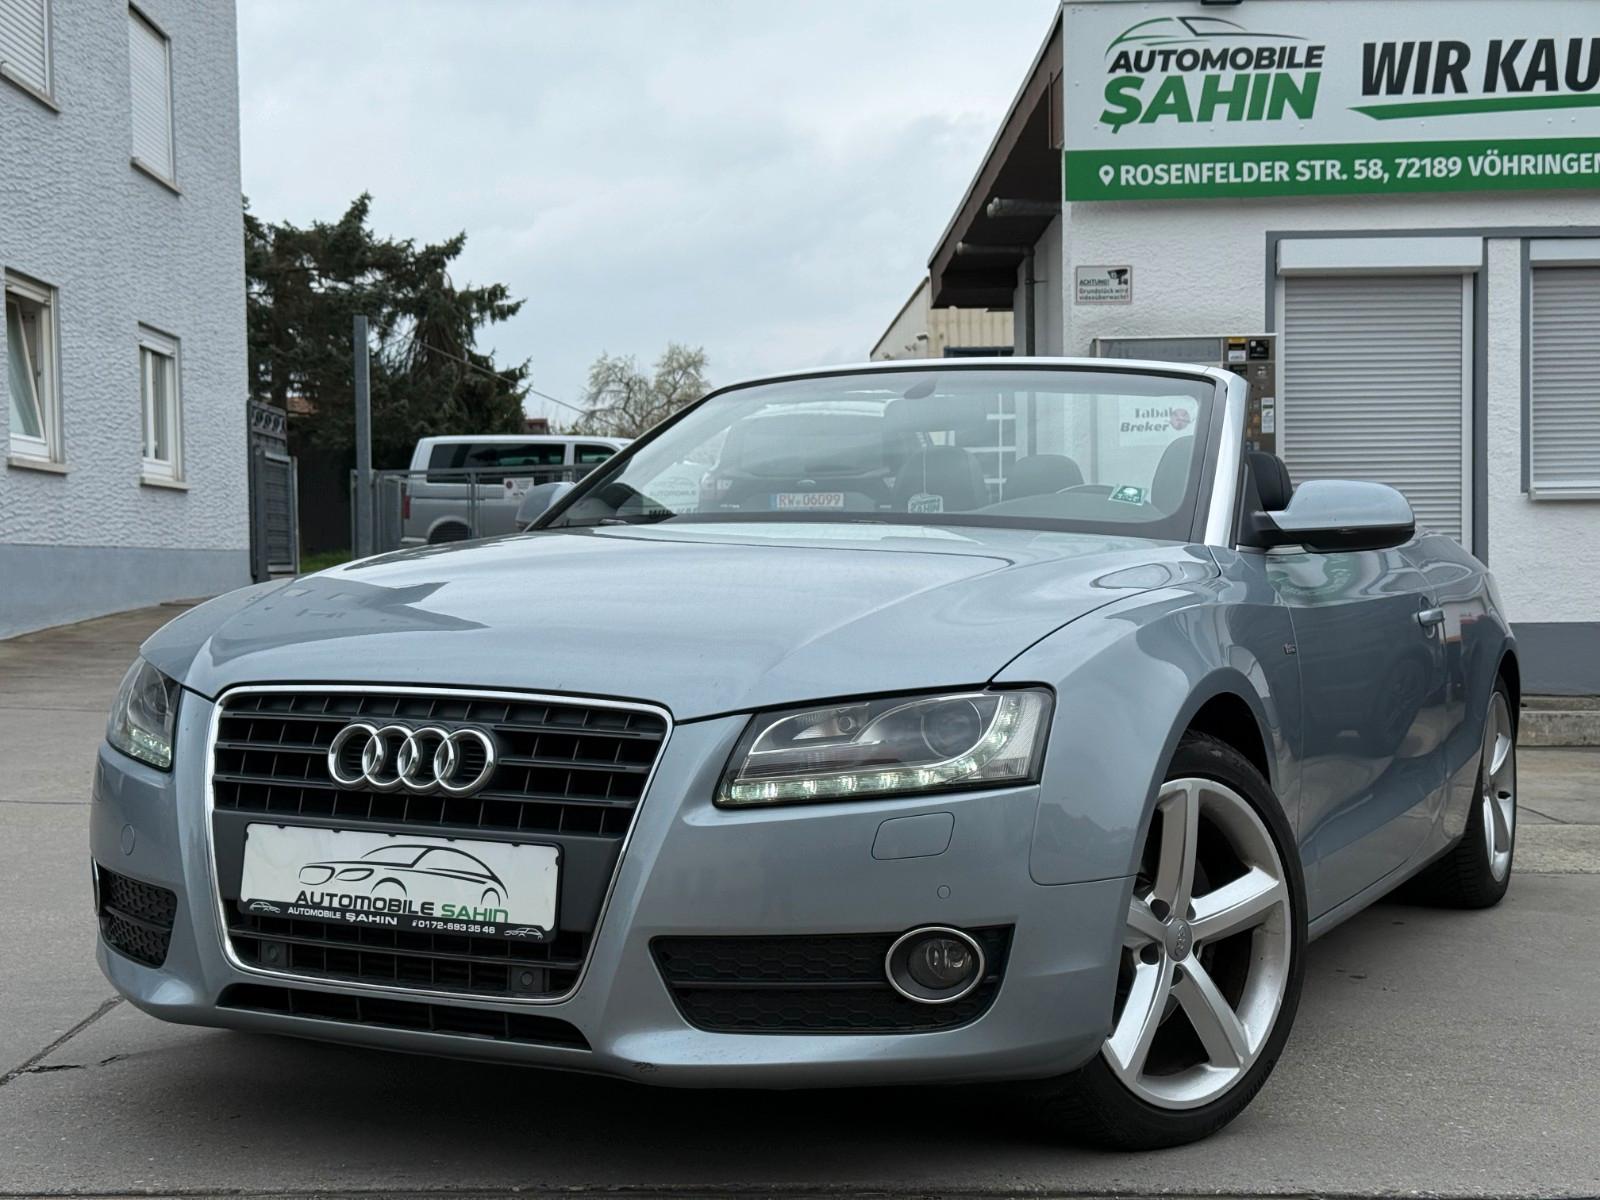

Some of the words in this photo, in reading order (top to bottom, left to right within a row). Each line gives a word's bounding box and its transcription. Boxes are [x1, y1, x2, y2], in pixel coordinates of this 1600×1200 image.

[1108, 45, 1325, 73] AUTOMOBILE
[1362, 41, 1471, 96] WIR
[1483, 38, 1600, 92] KAU
[1099, 72, 1322, 134] ŞAHIN
[1120, 160, 1290, 186] ROSENFELDER
[1295, 159, 1348, 181] STR.
[1353, 158, 1390, 183] 58,
[1395, 157, 1462, 178] 72189
[287, 906, 342, 919] AUTOMOBILE
[345, 912, 398, 925] ŞAHIN
[295, 890, 435, 916] AUTOMOBILE
